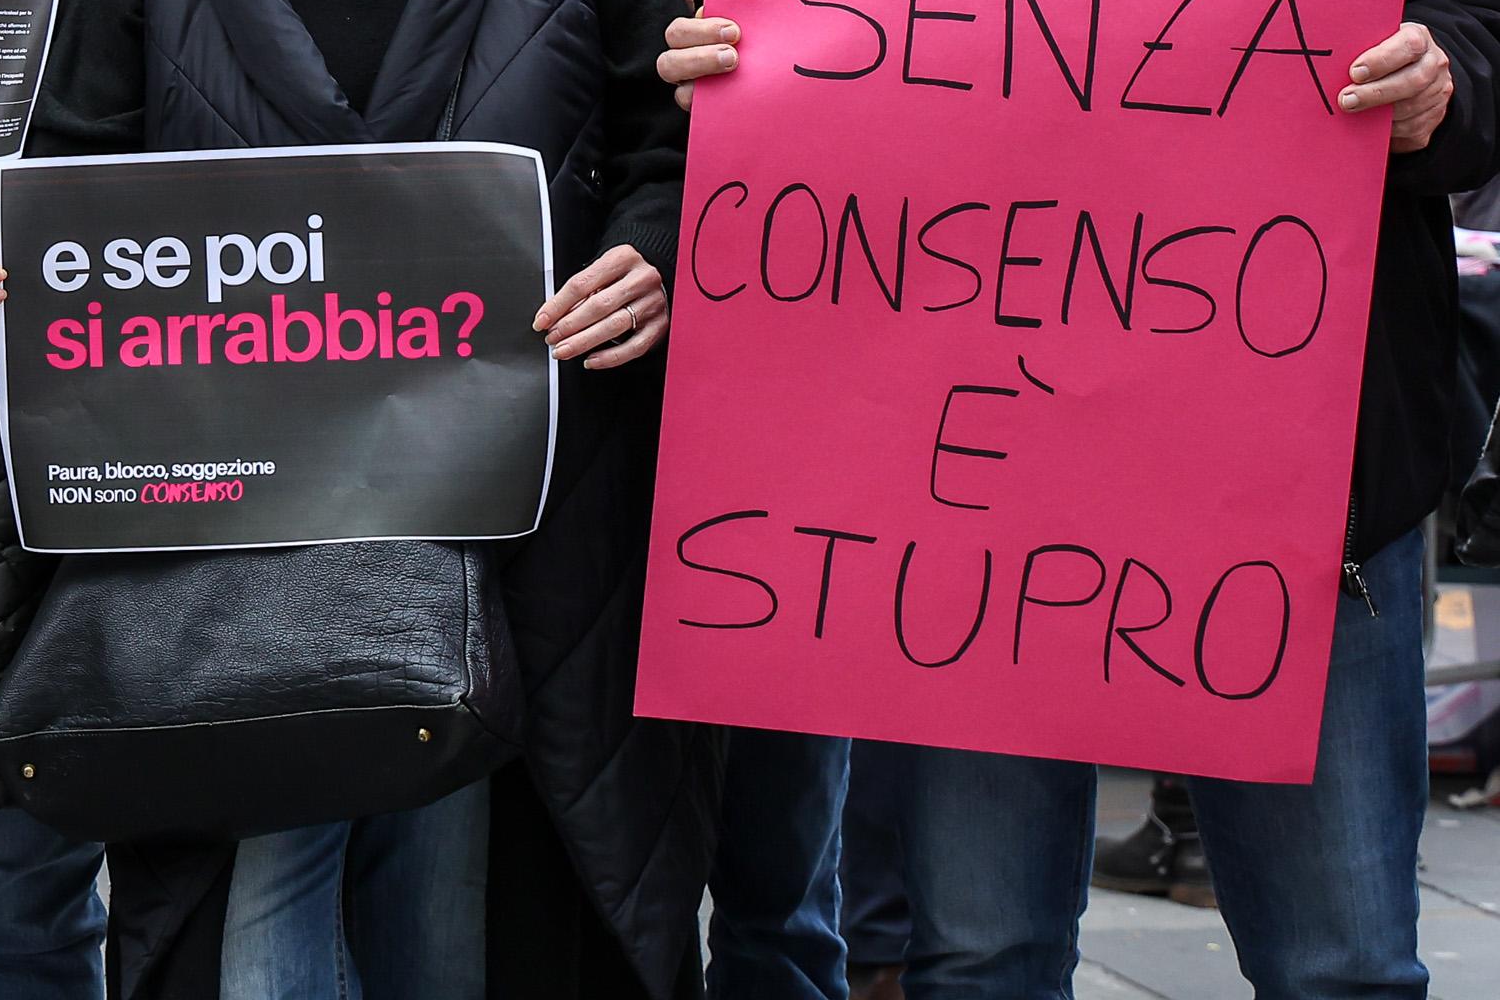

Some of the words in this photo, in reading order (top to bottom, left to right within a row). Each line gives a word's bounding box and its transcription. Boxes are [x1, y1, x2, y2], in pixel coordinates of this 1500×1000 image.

[42, 240, 90, 292] e
[102, 236, 191, 291] se
[206, 214, 325, 303] poi
[691, 180, 1328, 359] CONSENSO
[46, 301, 104, 370] si
[119, 291, 485, 366] arrabbia?
[48, 464, 102, 481] Paura,
[104, 461, 169, 480] blocco,
[171, 458, 275, 481] soggezione
[930, 354, 1055, 510] È
[49, 486, 91, 503] NON
[94, 488, 136, 502] sono
[140, 480, 243, 503] CONSENSO
[675, 508, 1291, 700] STUPRO
